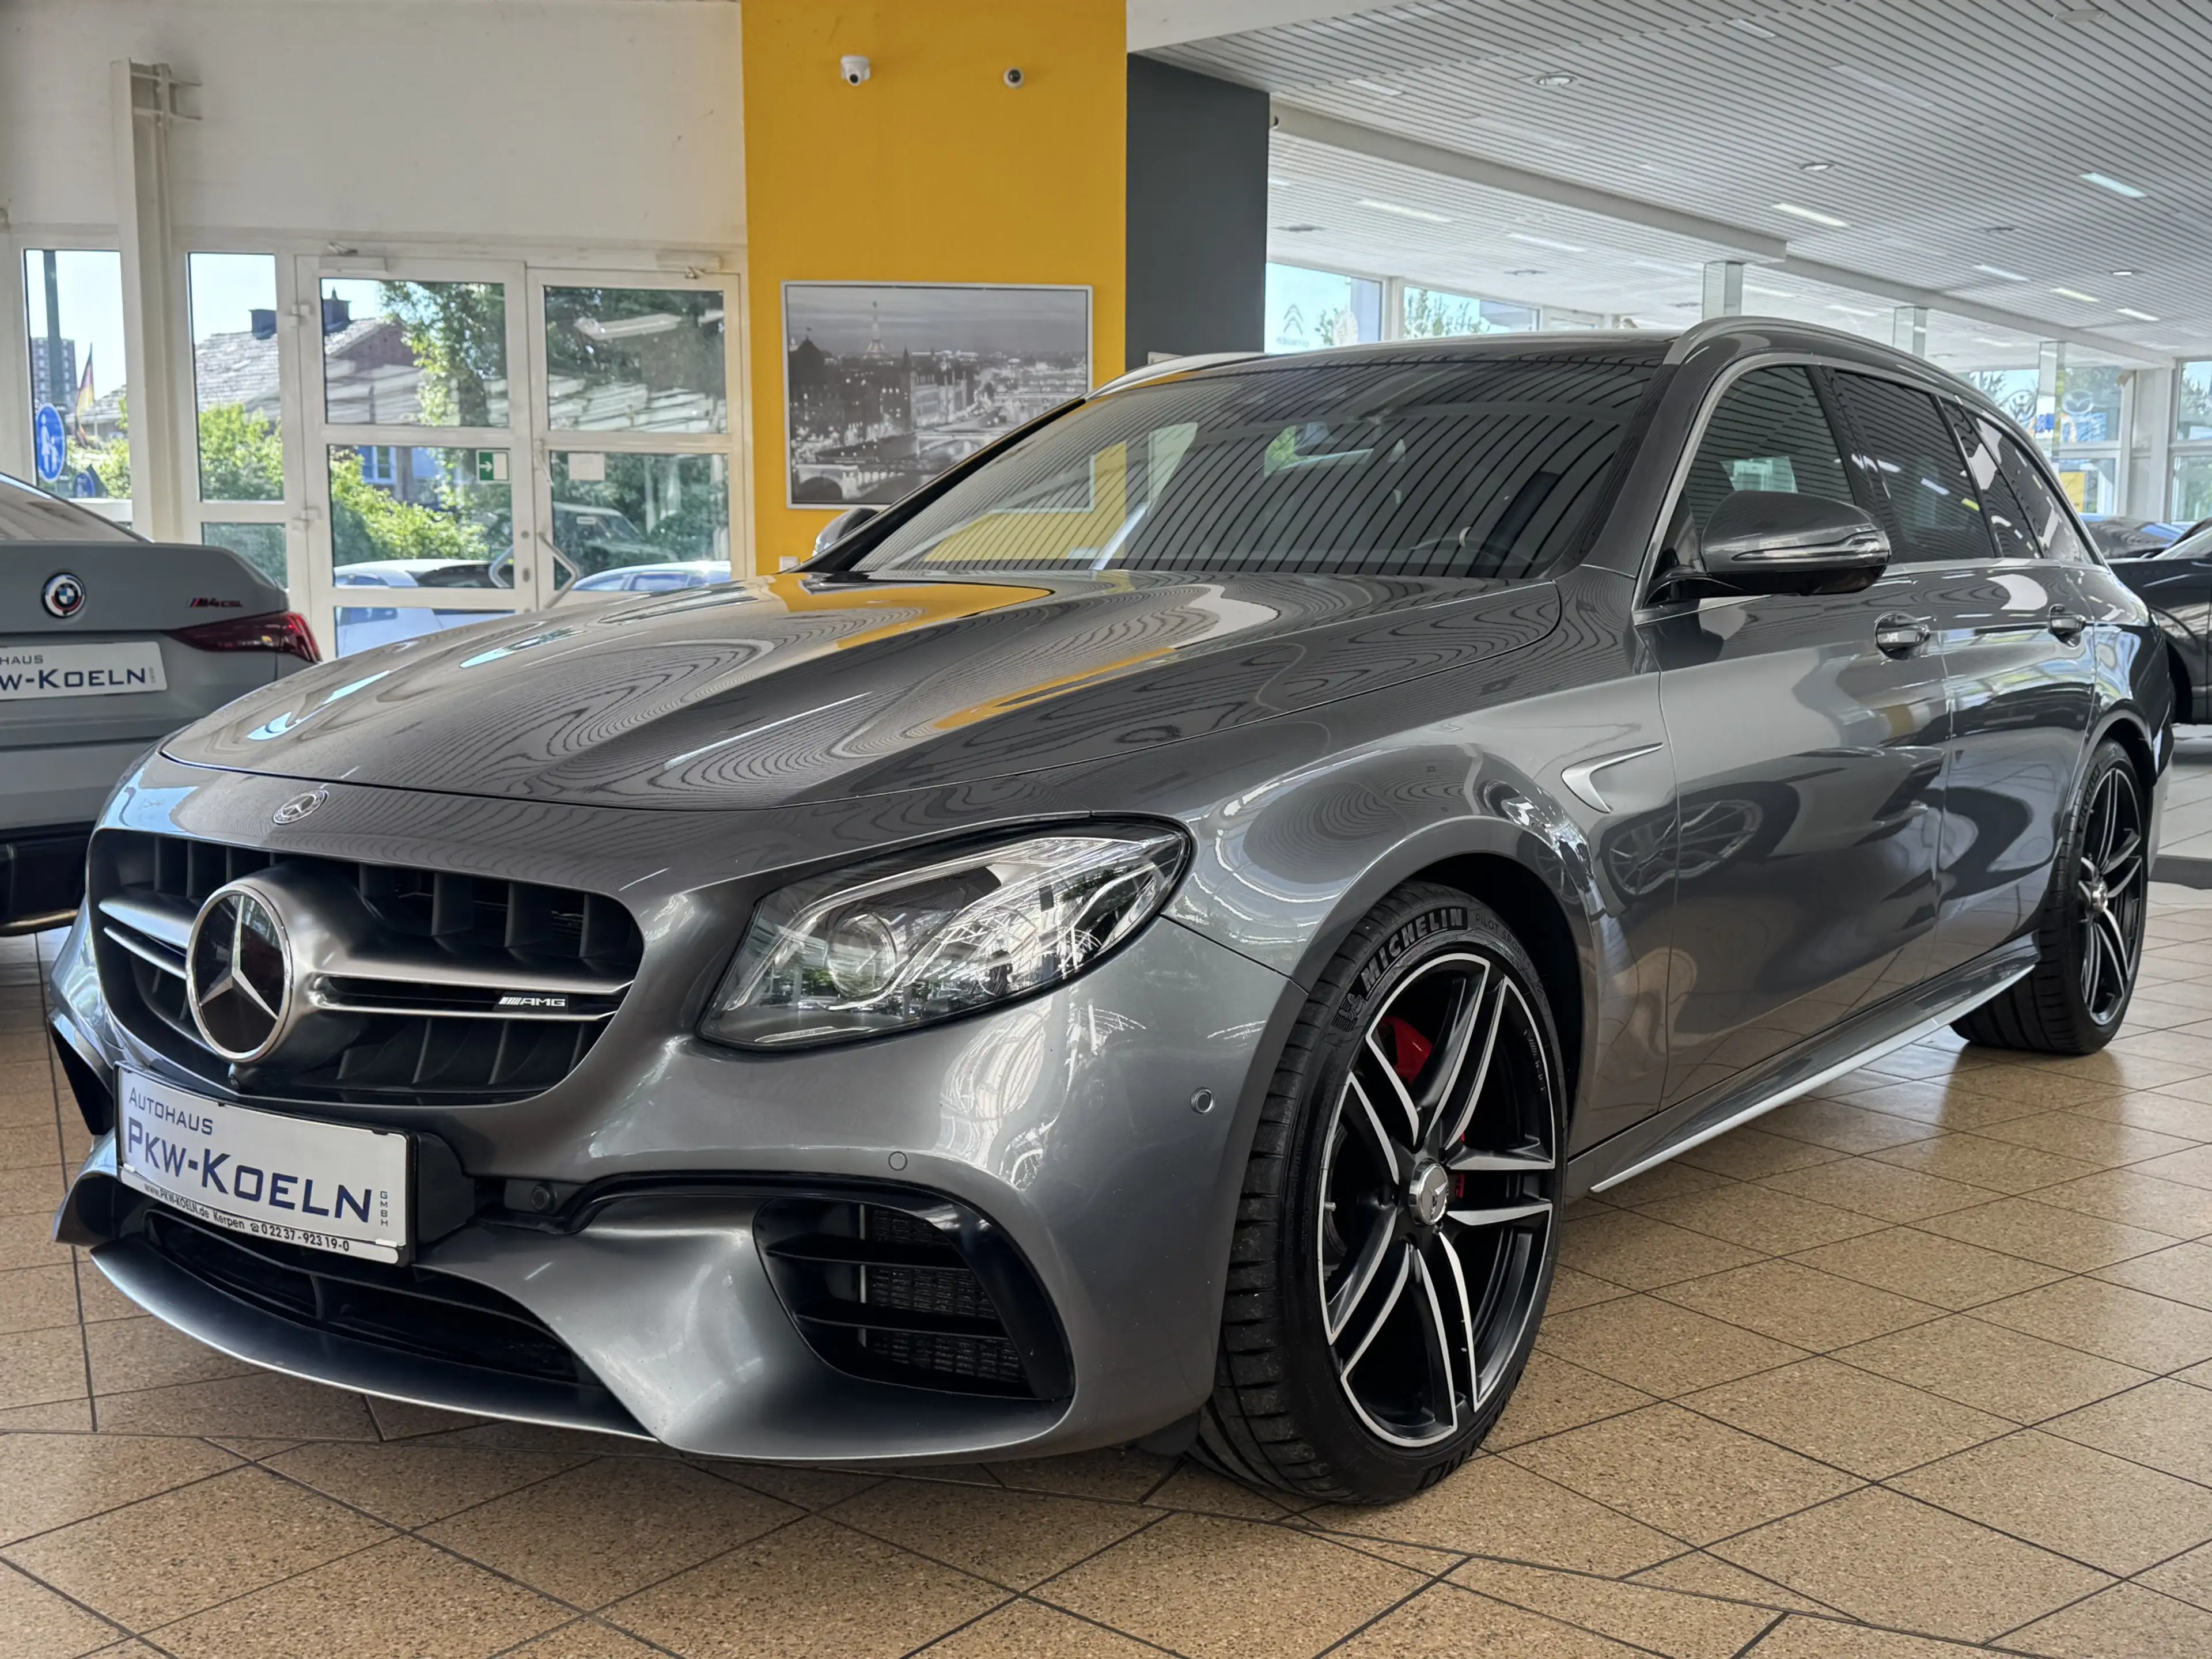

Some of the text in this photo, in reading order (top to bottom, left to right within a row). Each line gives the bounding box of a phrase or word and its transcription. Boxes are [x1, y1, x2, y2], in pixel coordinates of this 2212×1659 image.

[1475, 914, 1499, 934] PILOT
[1361, 908, 1463, 993] MICHELIN
[520, 998, 566, 1007] AMG
[129, 1086, 213, 1135] AUTOHAUS
[128, 1116, 372, 1224] PKW-KOELN
[213, 1211, 245, 1229] Kerpen
[380, 1191, 388, 1227] GMBH
